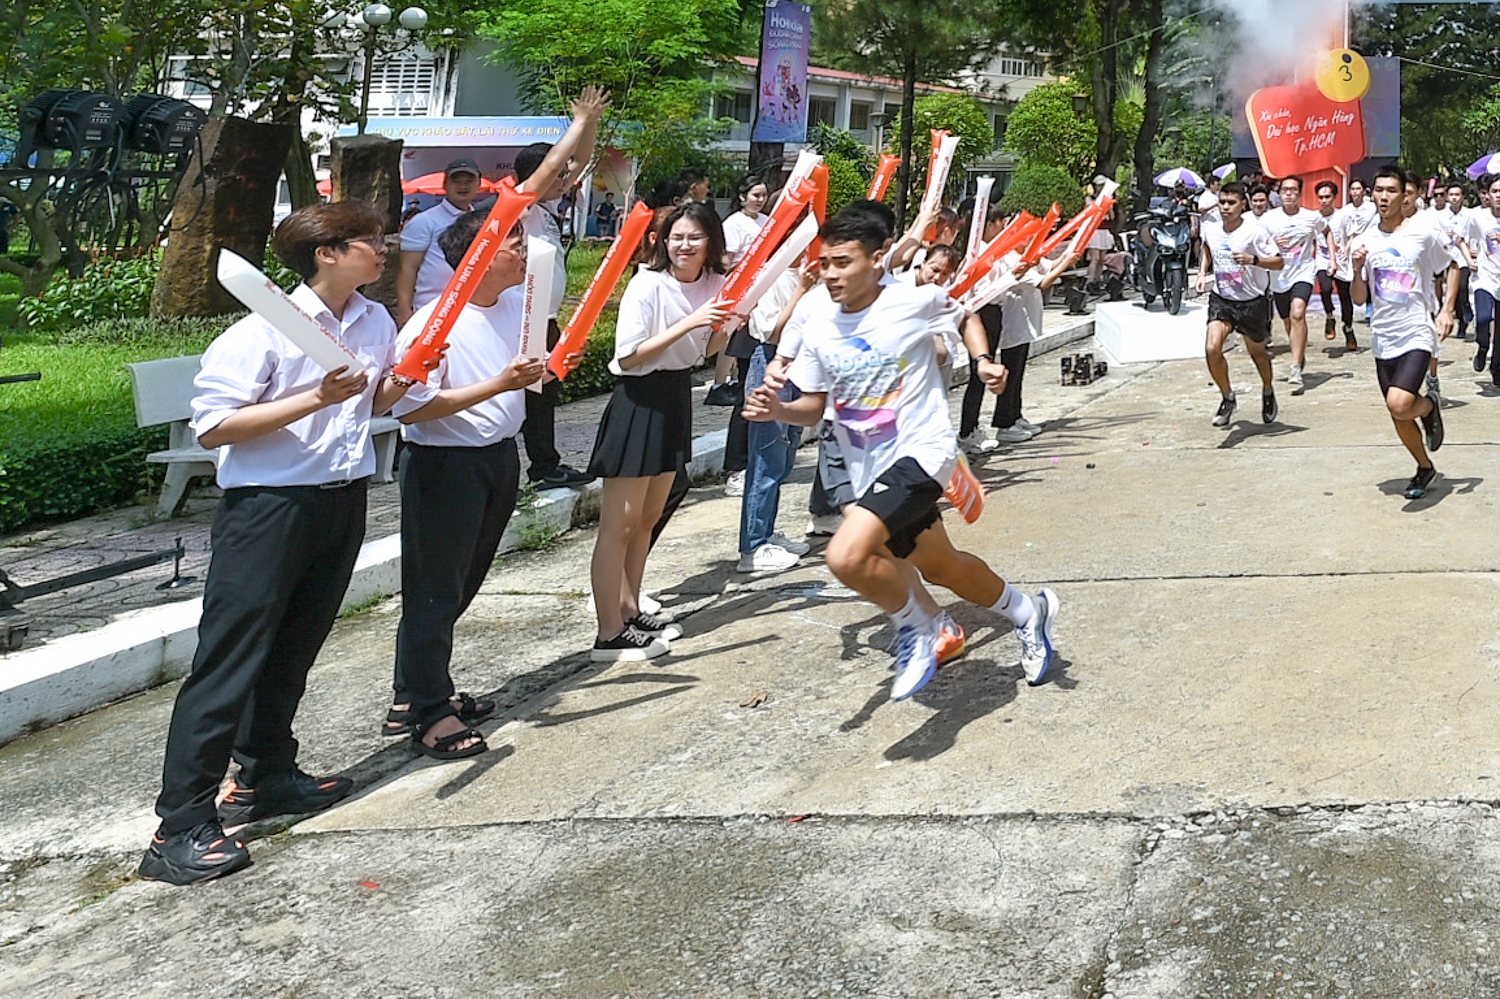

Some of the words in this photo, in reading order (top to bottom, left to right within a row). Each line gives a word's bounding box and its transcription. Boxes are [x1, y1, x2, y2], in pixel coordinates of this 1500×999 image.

[770, 11, 802, 33] Honda
[1260, 110, 1272, 122] Xin
[1274, 108, 1292, 119] chào,
[1266, 124, 1282, 140] Đại
[1285, 122, 1300, 136] học
[1304, 116, 1328, 134] Ngân
[1332, 109, 1355, 126] Hàng
[372, 128, 393, 136] KHU
[396, 128, 419, 137] VỰC
[422, 126, 452, 136] KHẢO
[478, 126, 494, 136] LÁI
[497, 127, 520, 136] THỬ
[522, 128, 535, 136] XE
[536, 127, 560, 138] ĐIỆN
[1294, 130, 1336, 157] Tp.HCM
[468, 238, 491, 267] Honda
[725, 272, 741, 292] Honda
[737, 259, 748, 274] UNI
[750, 238, 762, 257] SỐNG
[761, 218, 777, 239] ĐỘNG
[458, 266, 475, 284] UNI
[528, 274, 536, 295] ĐỘNG
[438, 290, 460, 319] SỐNG
[525, 296, 533, 316] SỐNG
[422, 318, 444, 346] ĐỘNG
[521, 336, 530, 355] Honda
